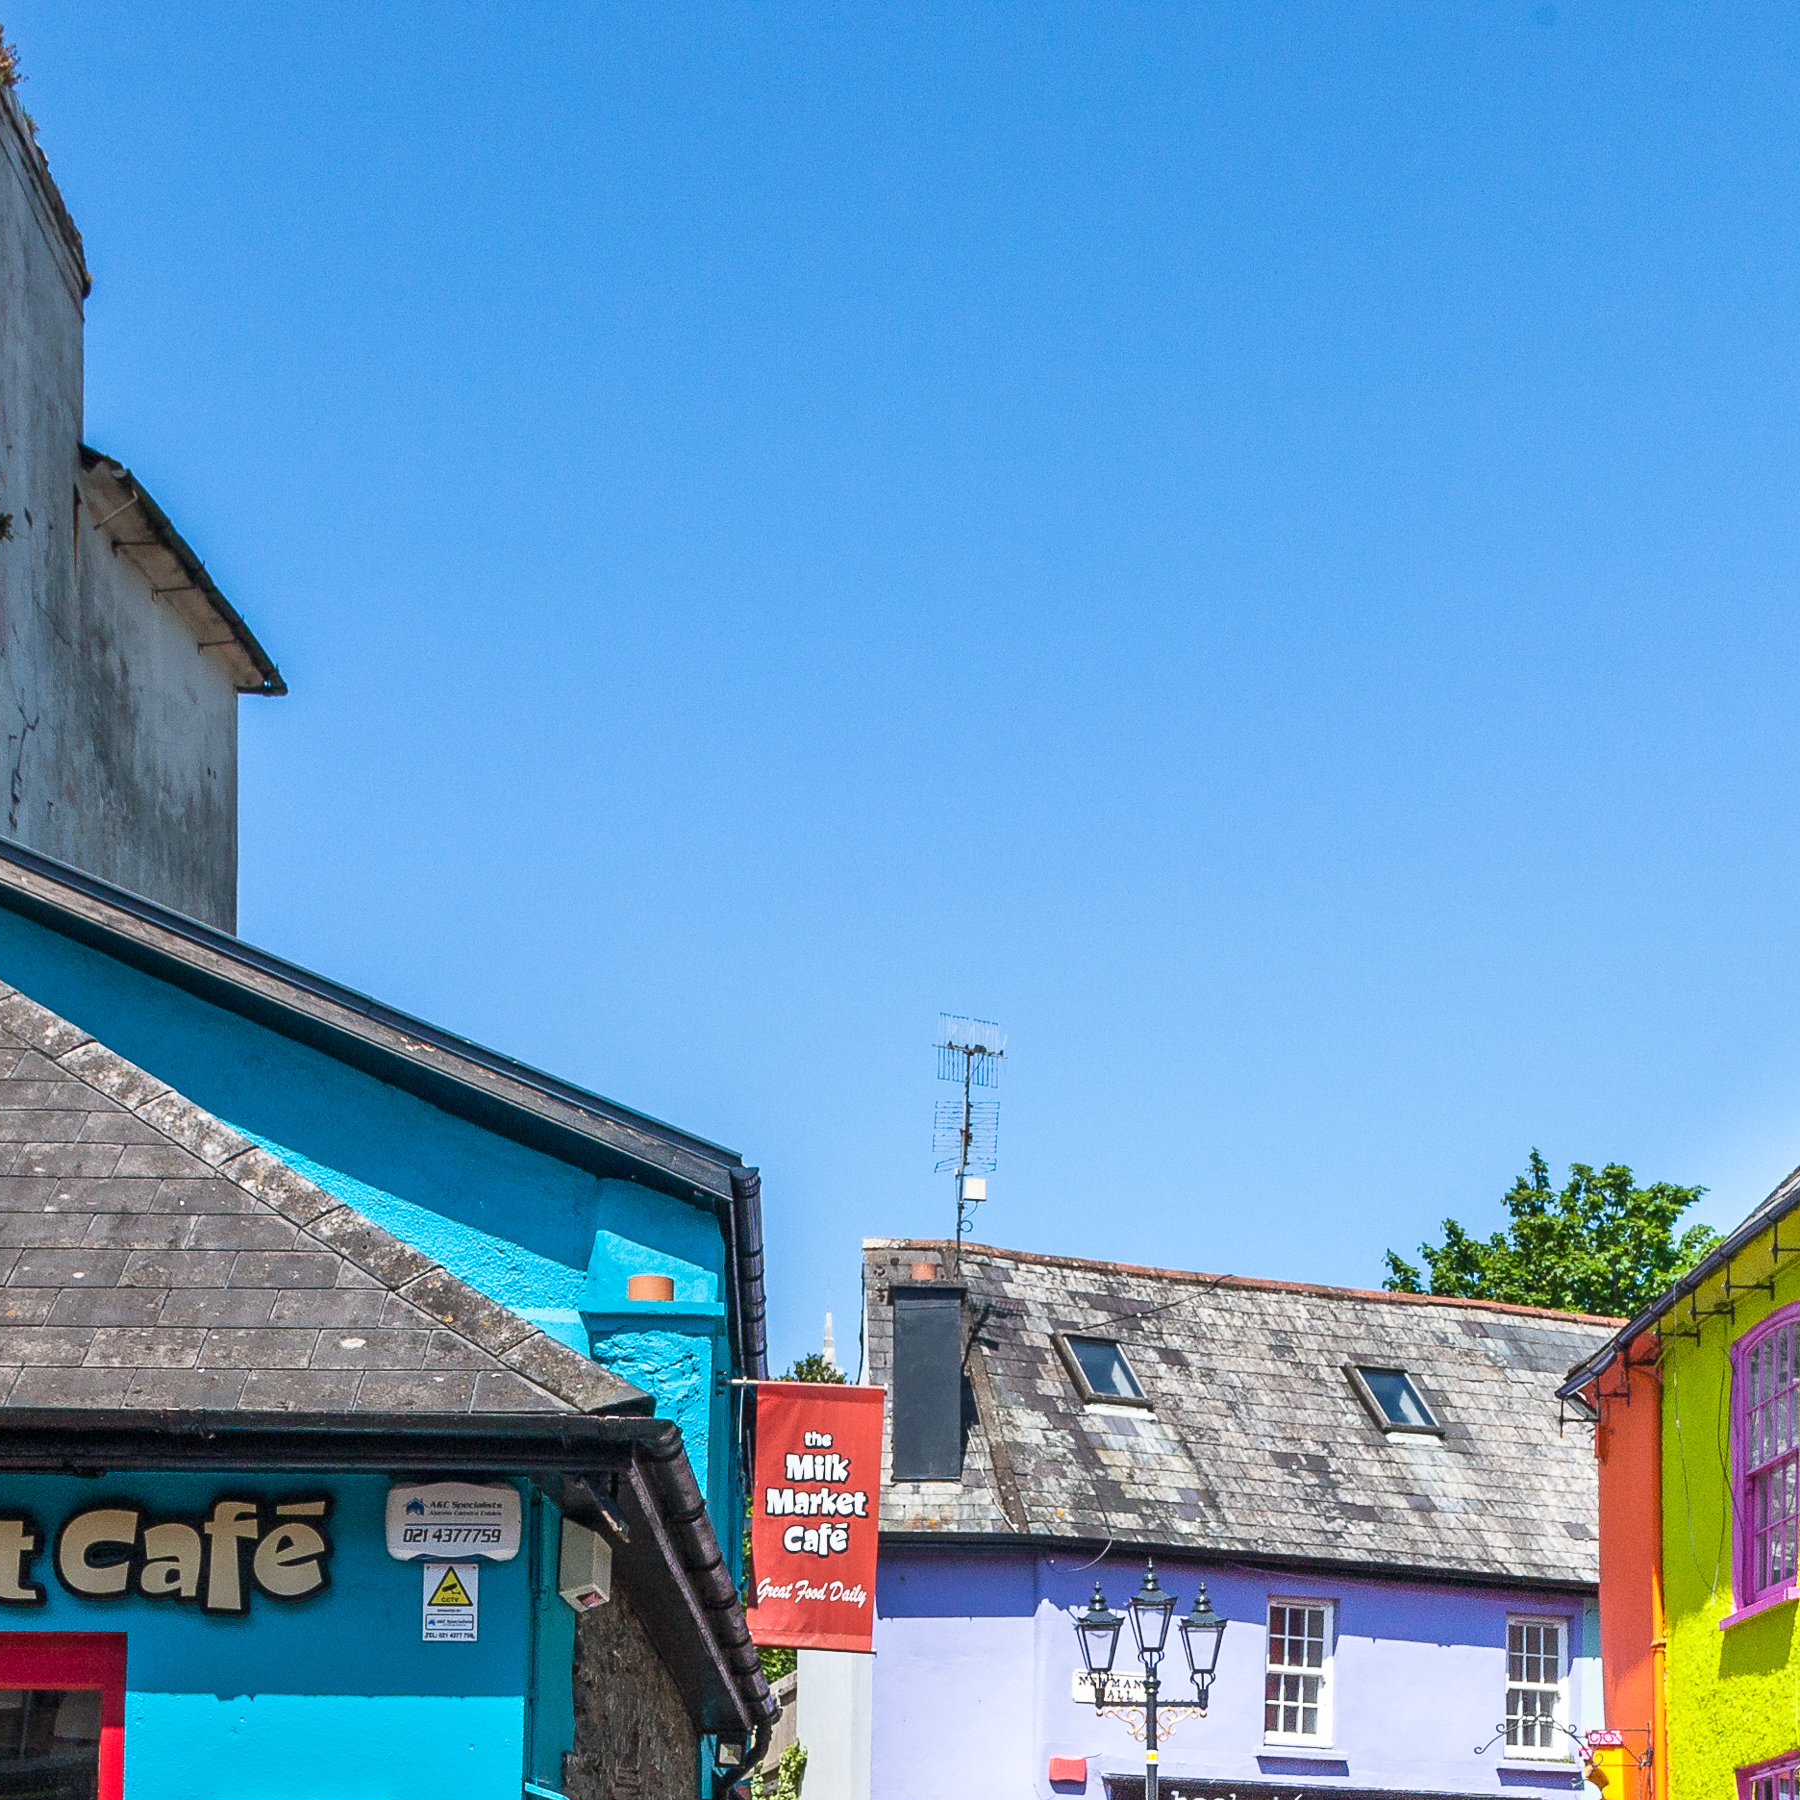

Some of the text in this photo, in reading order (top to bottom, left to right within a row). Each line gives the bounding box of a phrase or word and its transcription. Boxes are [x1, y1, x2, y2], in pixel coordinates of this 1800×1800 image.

[804, 1431, 833, 1448] the
[785, 1453, 851, 1482] Milk
[766, 1487, 869, 1518] Market
[403, 1528, 502, 1542] 021 4377759
[757, 1577, 867, 1608] Great Food Daily
